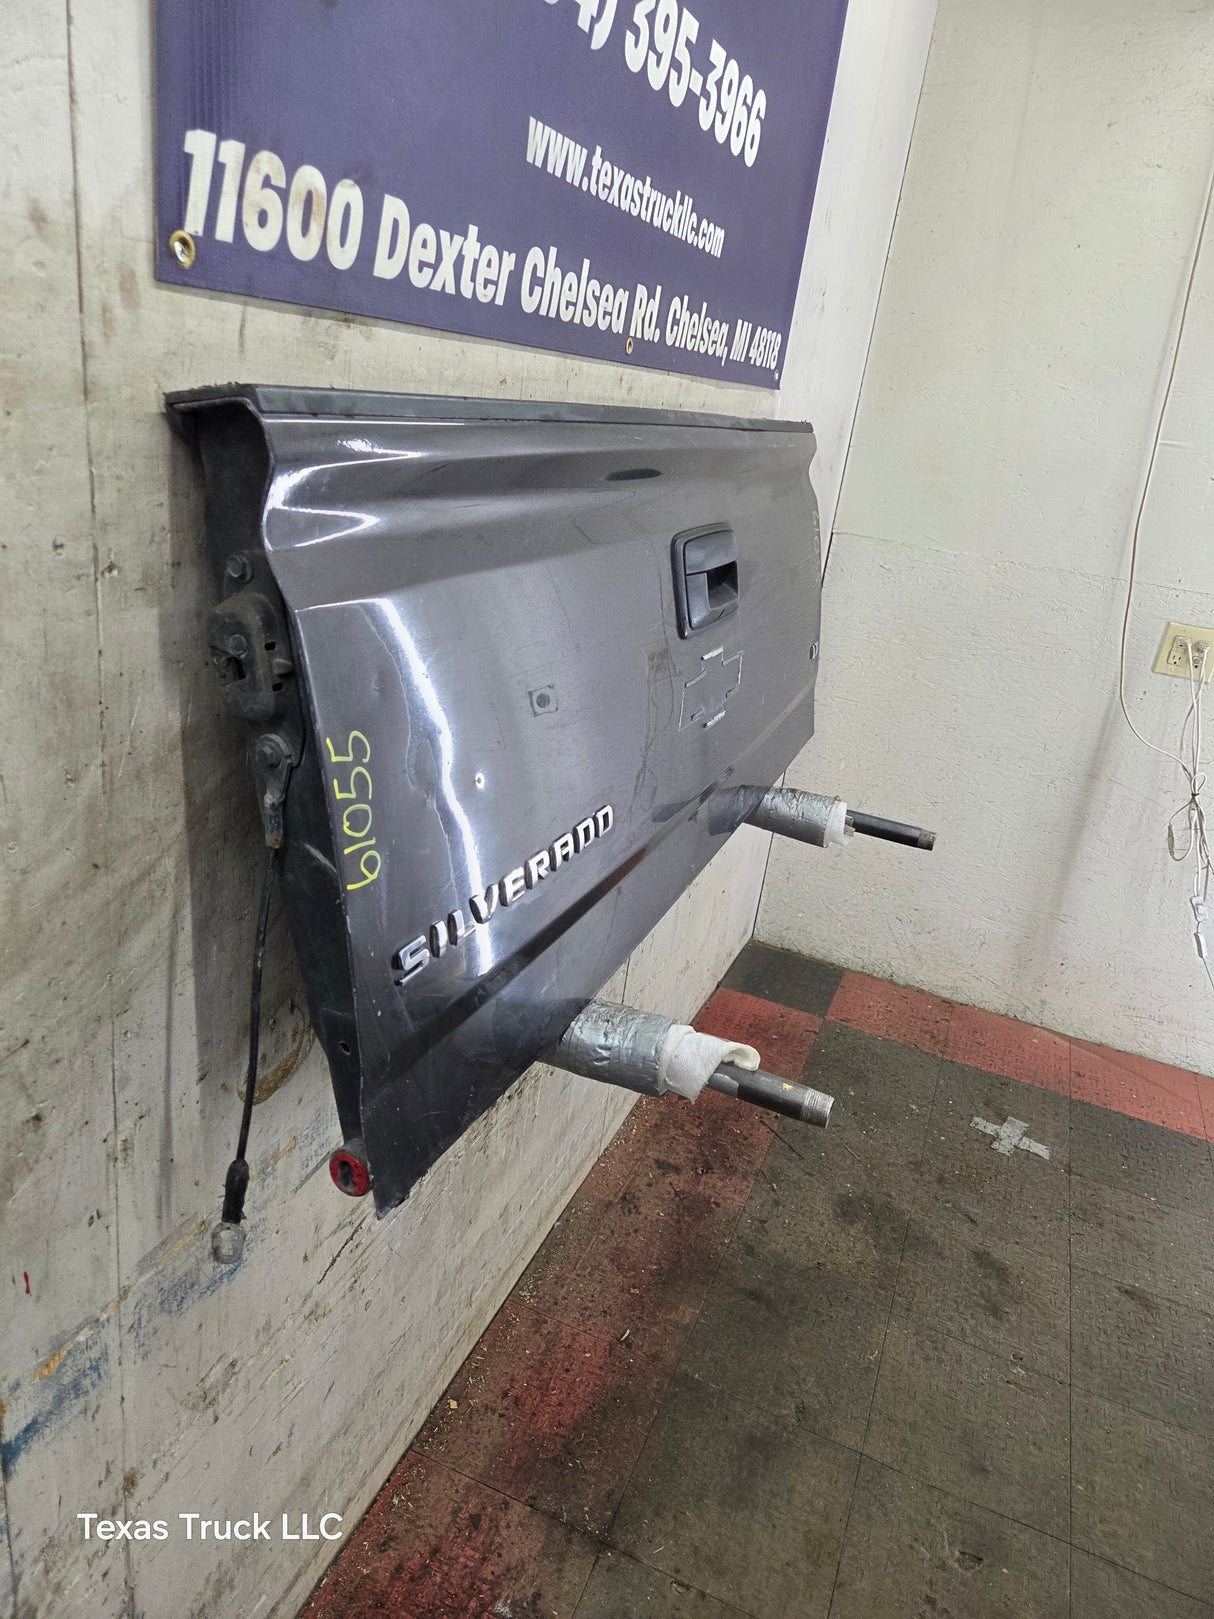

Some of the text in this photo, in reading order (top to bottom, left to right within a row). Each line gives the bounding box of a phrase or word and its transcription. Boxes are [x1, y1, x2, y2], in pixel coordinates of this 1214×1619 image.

[625, 0, 767, 167] 395-3966
[184, 129, 782, 370] 11600 Dexter Chelsea Rd. Chelsea, MI 48118
[526, 116, 725, 258] www.texastruckllc.com
[325, 730, 382, 890] 61055
[391, 804, 614, 986] SILVERADO
